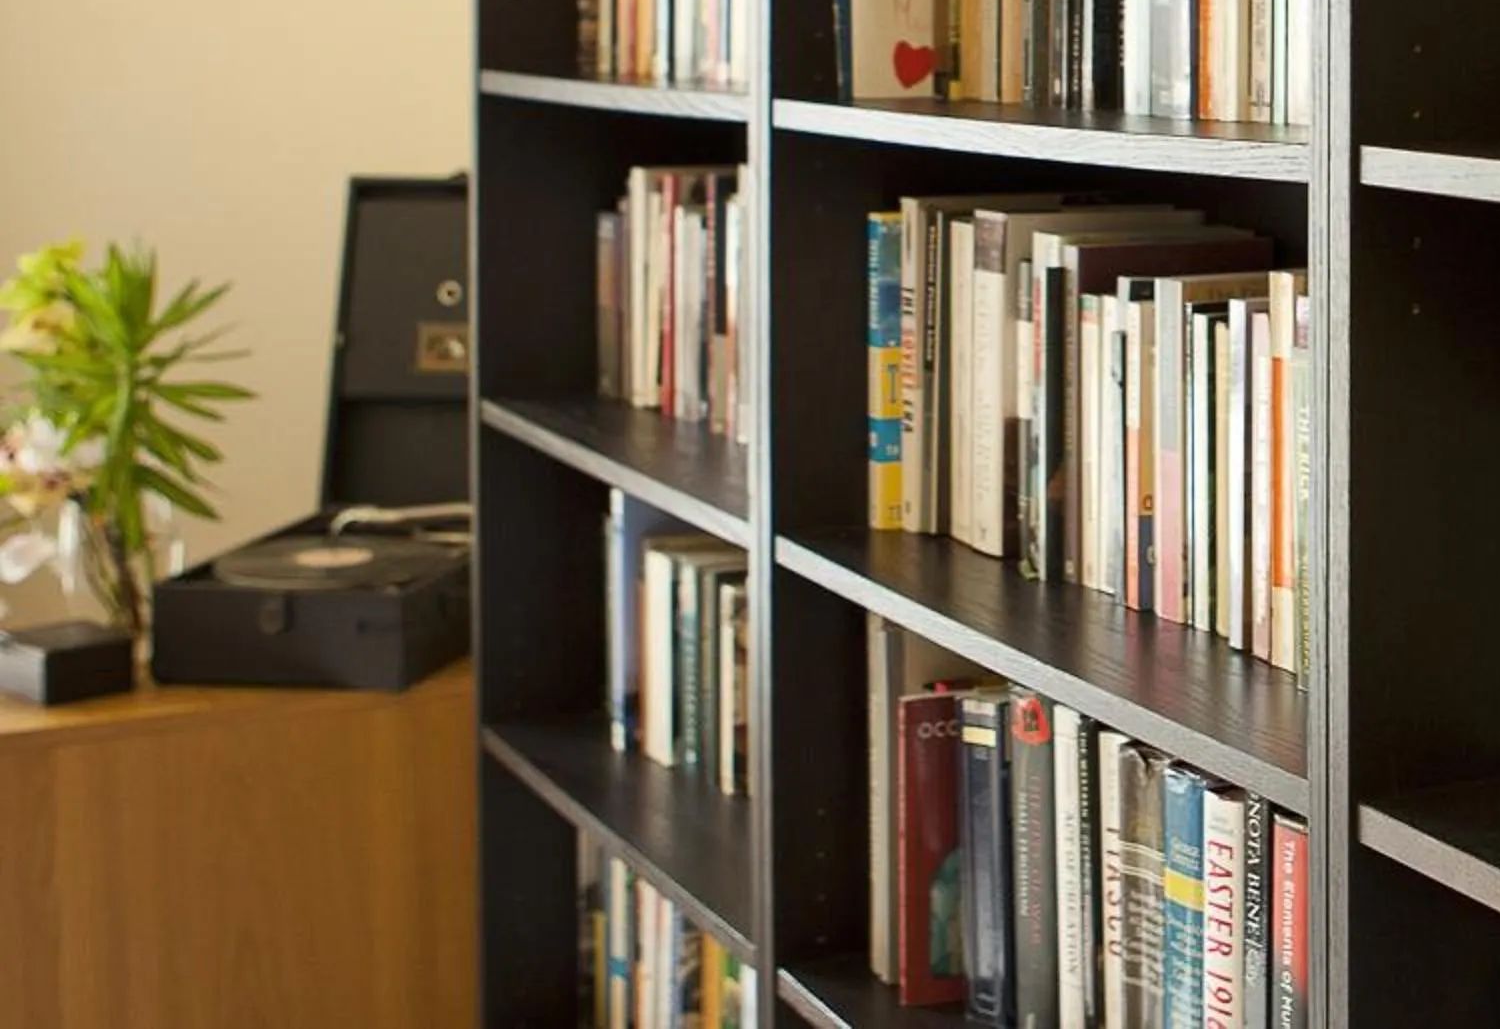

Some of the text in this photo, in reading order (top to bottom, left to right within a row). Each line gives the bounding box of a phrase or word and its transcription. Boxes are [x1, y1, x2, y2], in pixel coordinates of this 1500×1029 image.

[902, 286, 917, 318] THE
[902, 398, 917, 434] ERA
[1246, 800, 1265, 865] NOTA
[1206, 839, 1234, 958] EASTER
[1246, 873, 1265, 934] BENE
[1279, 839, 1297, 1029] The Elements of Mur
